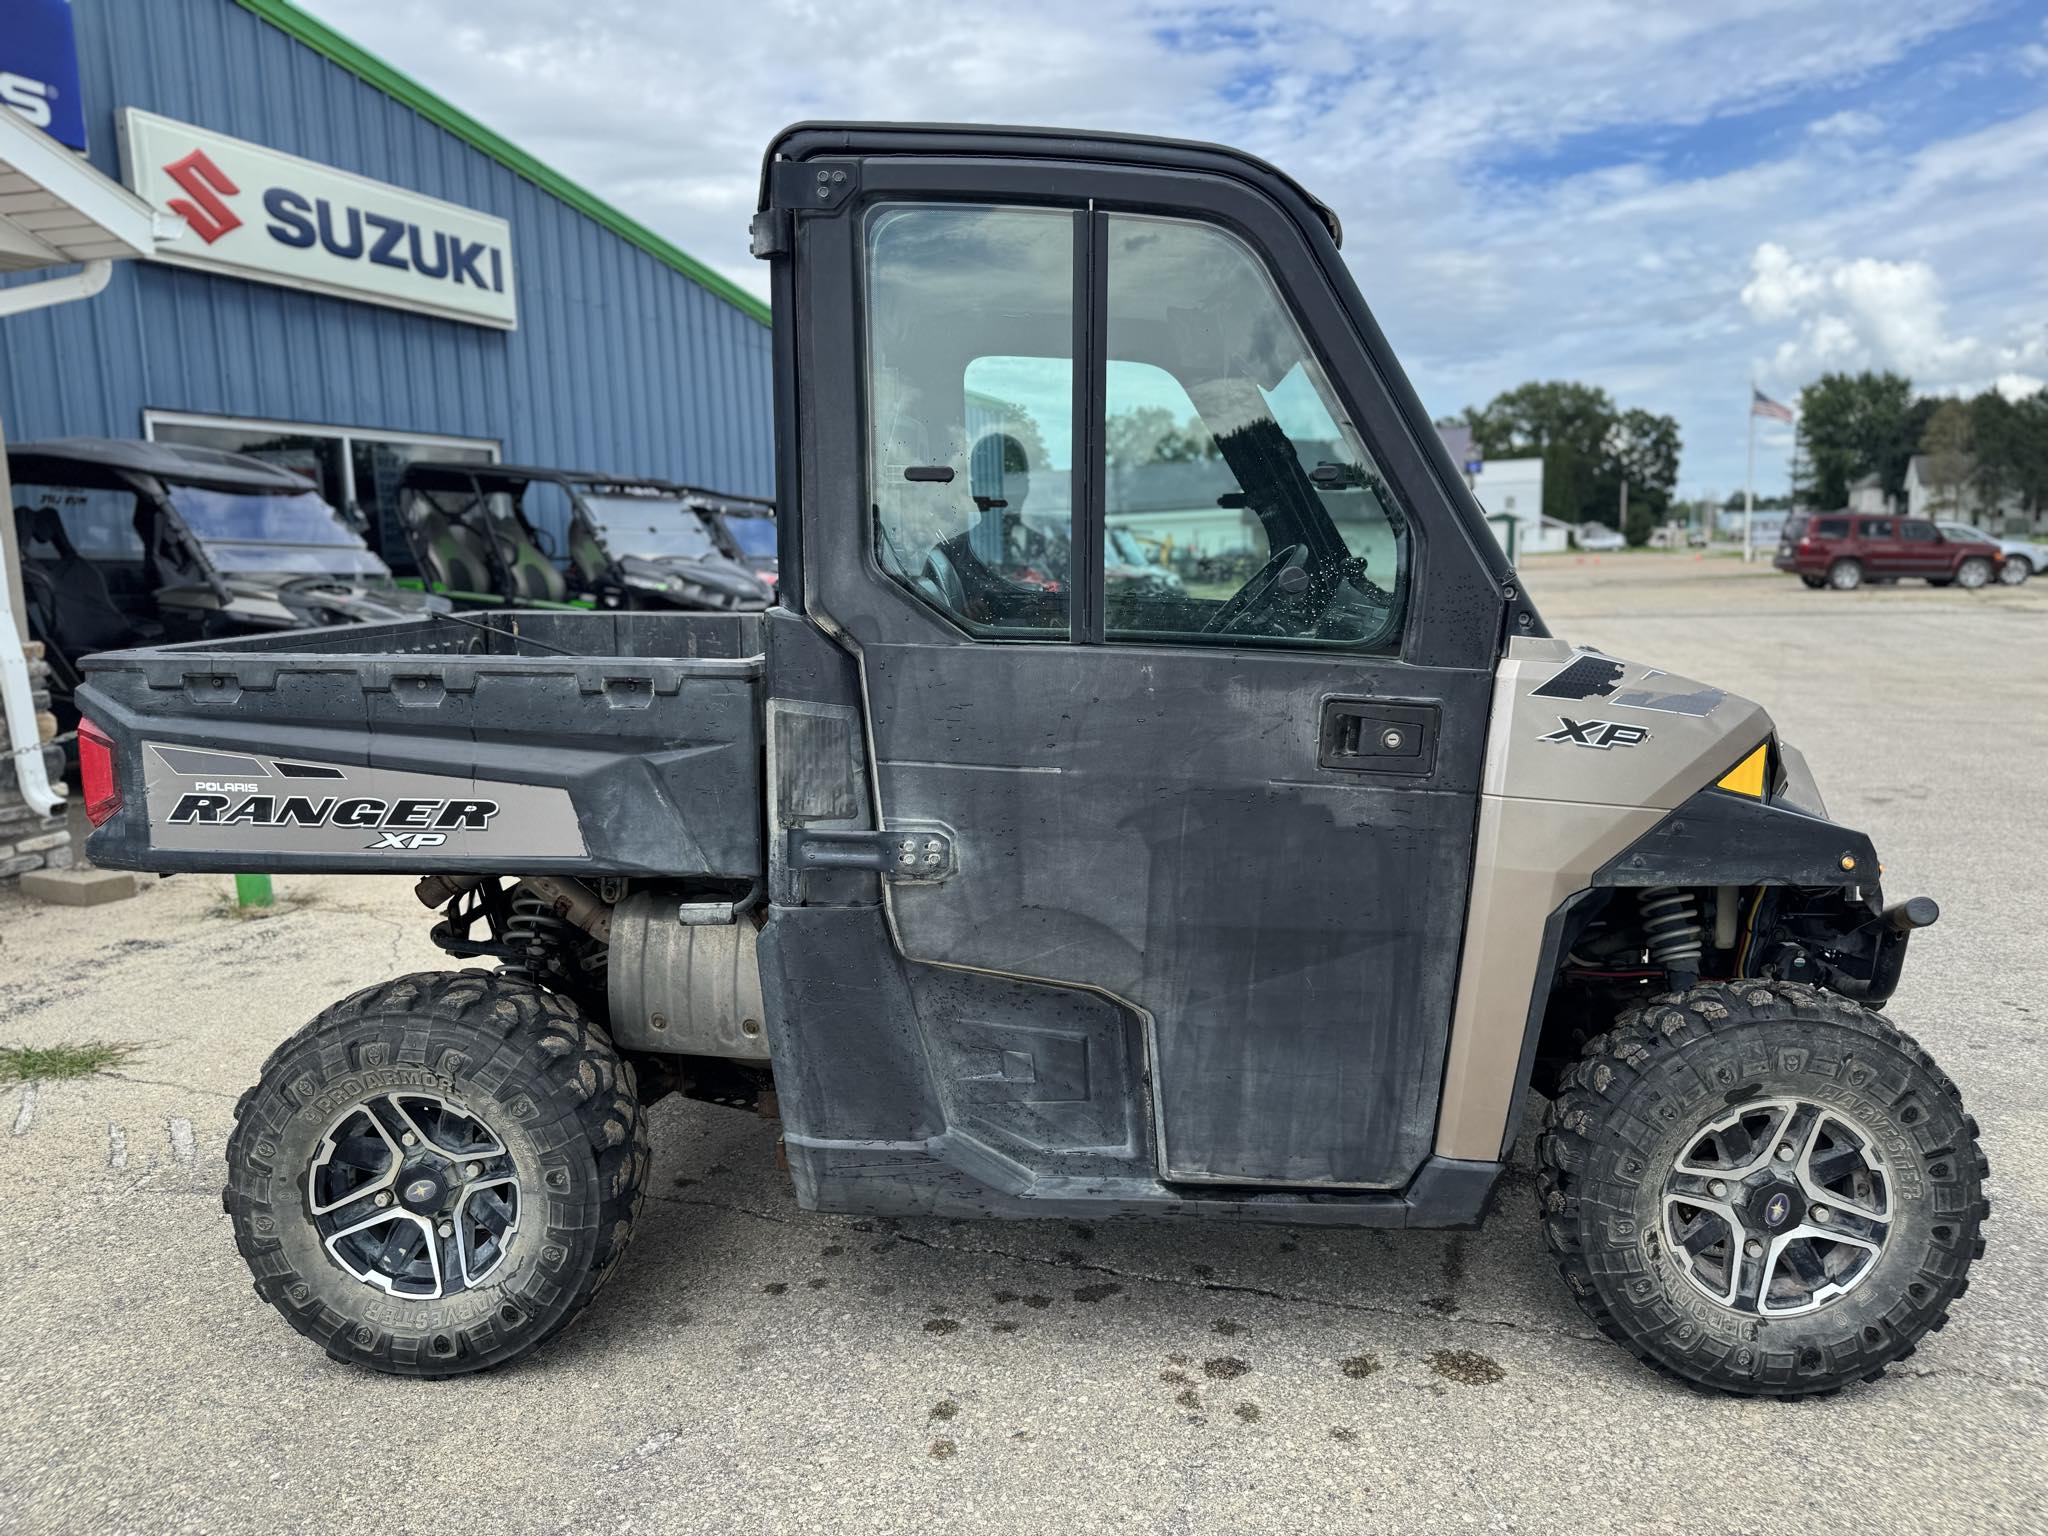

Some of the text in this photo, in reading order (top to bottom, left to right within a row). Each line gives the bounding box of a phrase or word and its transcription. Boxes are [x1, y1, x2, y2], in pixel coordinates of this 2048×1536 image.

[263, 187, 504, 293] SUZUKI
[1536, 716, 1652, 750] XP
[194, 781, 258, 792] POLARIS
[166, 793, 499, 829] RANGER
[364, 831, 448, 850] XP
[312, 1068, 457, 1115] PRO ARMOR
[1814, 1083, 1922, 1200] HARVESTER
[362, 1285, 504, 1331] HARVESTER
